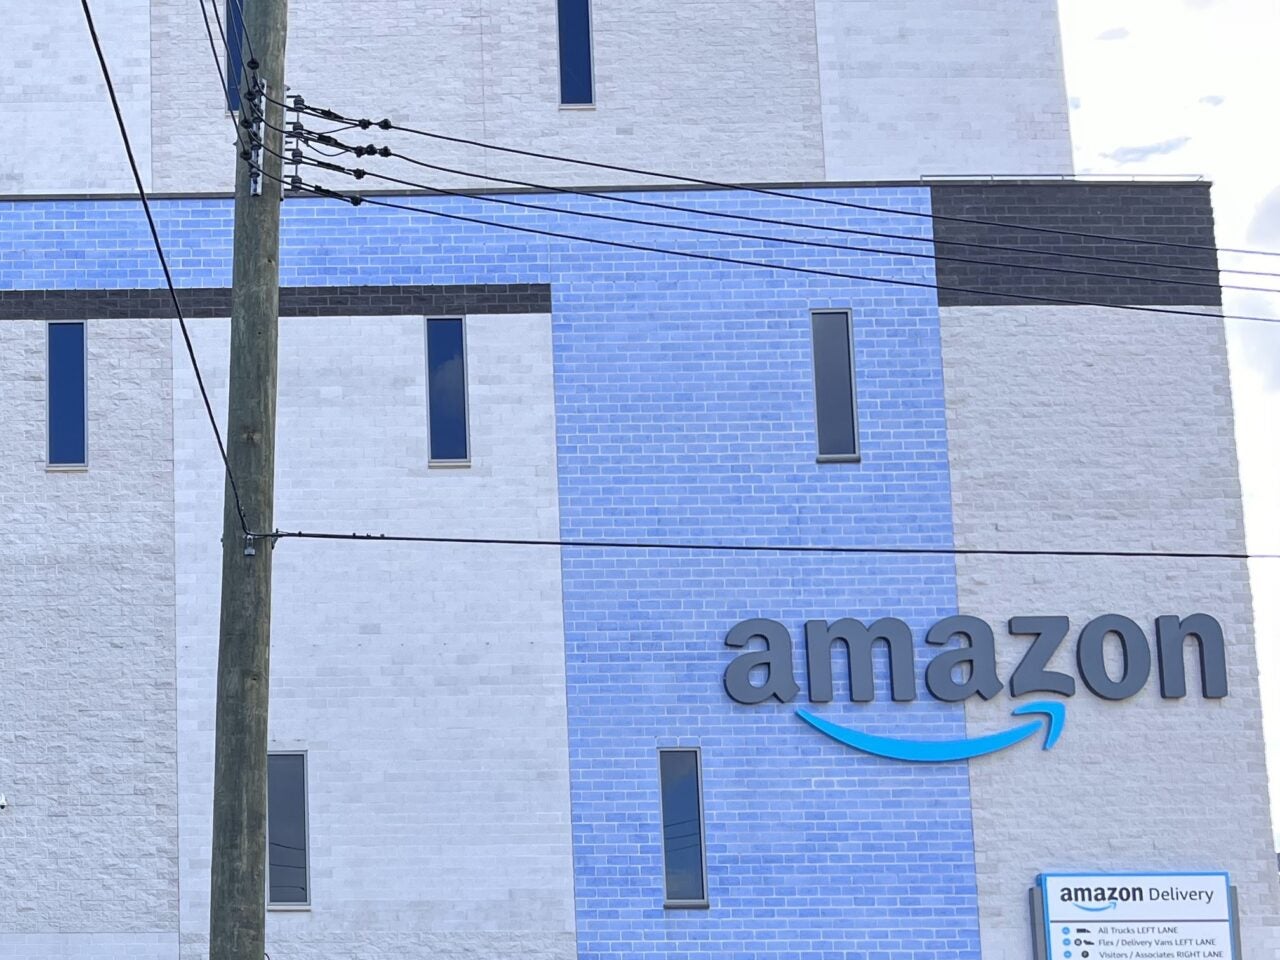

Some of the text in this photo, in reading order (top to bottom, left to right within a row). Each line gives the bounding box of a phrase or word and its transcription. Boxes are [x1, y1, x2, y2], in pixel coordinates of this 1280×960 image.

[723, 613, 1228, 704] amazon
[1060, 886, 1214, 904] amazon Delivery
[1098, 926, 1179, 935] All Trucks LEFT LANE
[1121, 939, 1153, 948] Delivery
[1175, 938, 1193, 946] LEFT
[1195, 938, 1216, 946] LANE
[1099, 951, 1128, 959] Visitors
[1135, 951, 1175, 959] Associates
[1176, 950, 1200, 958] RIGHT
[1203, 950, 1224, 958] LANE
